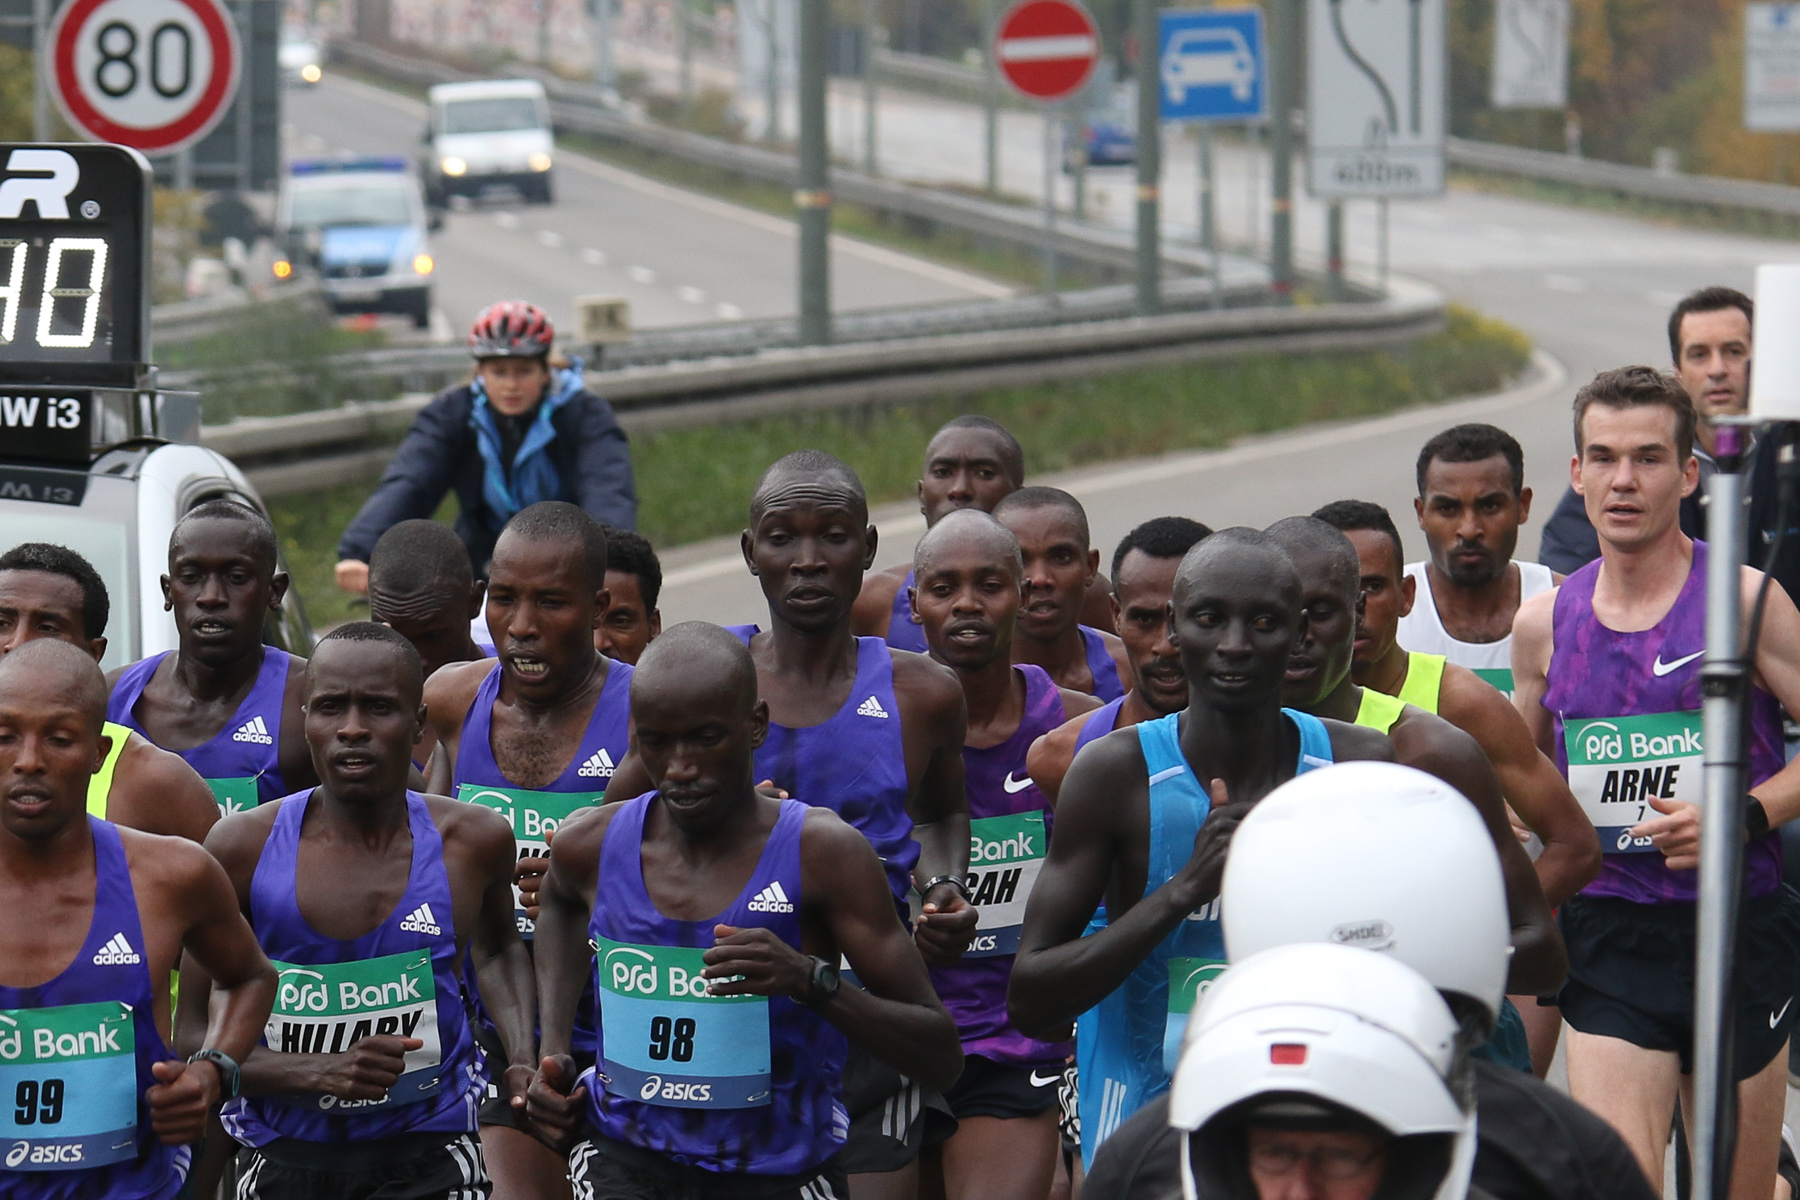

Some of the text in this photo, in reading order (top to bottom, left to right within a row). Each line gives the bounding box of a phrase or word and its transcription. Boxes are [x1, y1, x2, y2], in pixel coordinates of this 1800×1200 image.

[96, 22, 192, 98] 80
[46, 397, 81, 430] i3
[856, 706, 889, 719] adidas
[232, 731, 273, 746] adidas
[1629, 727, 1704, 759] Bank
[1600, 764, 1680, 804] ARNE
[1637, 805, 1646, 821] 7
[970, 831, 1034, 862] Bank
[747, 900, 794, 914] adidas
[400, 919, 442, 936] adidas
[93, 951, 141, 966] adidas
[338, 973, 422, 1010] Bank
[668, 967, 753, 999] Ba
[33, 1023, 121, 1060] Bank
[648, 1016, 697, 1063] 98
[13, 1078, 65, 1126] 99
